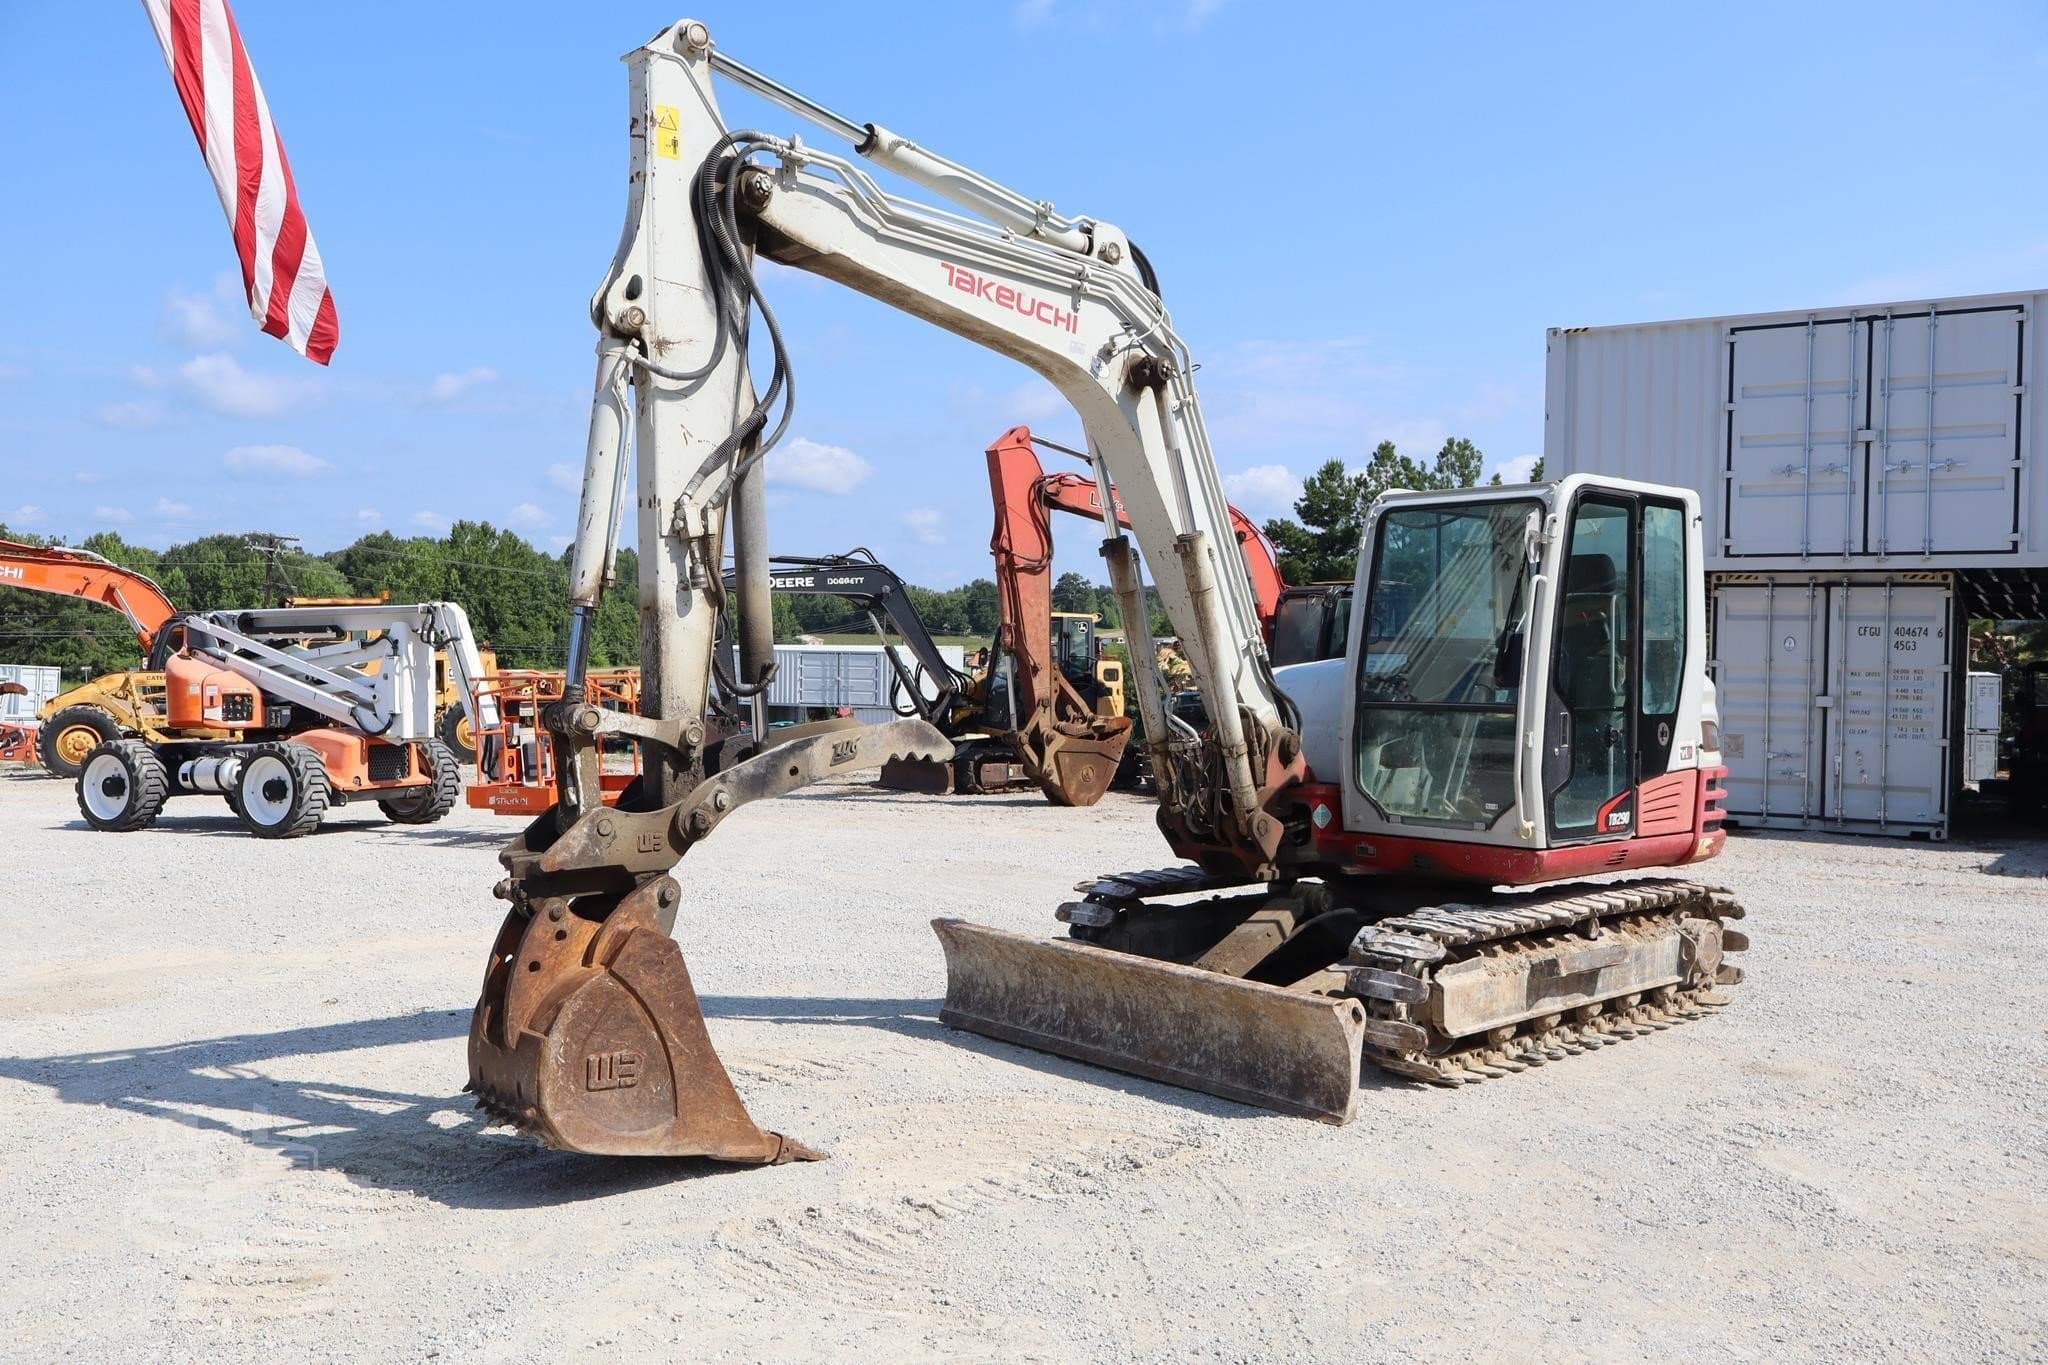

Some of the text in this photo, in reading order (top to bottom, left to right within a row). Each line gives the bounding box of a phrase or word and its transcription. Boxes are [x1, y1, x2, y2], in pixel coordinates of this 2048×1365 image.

[827, 577, 864, 585] DOGGETT
[1858, 626, 1944, 638] CFGU 404674 6
[1893, 640, 1916, 651] 45G3
[1608, 811, 1630, 826] TB290
